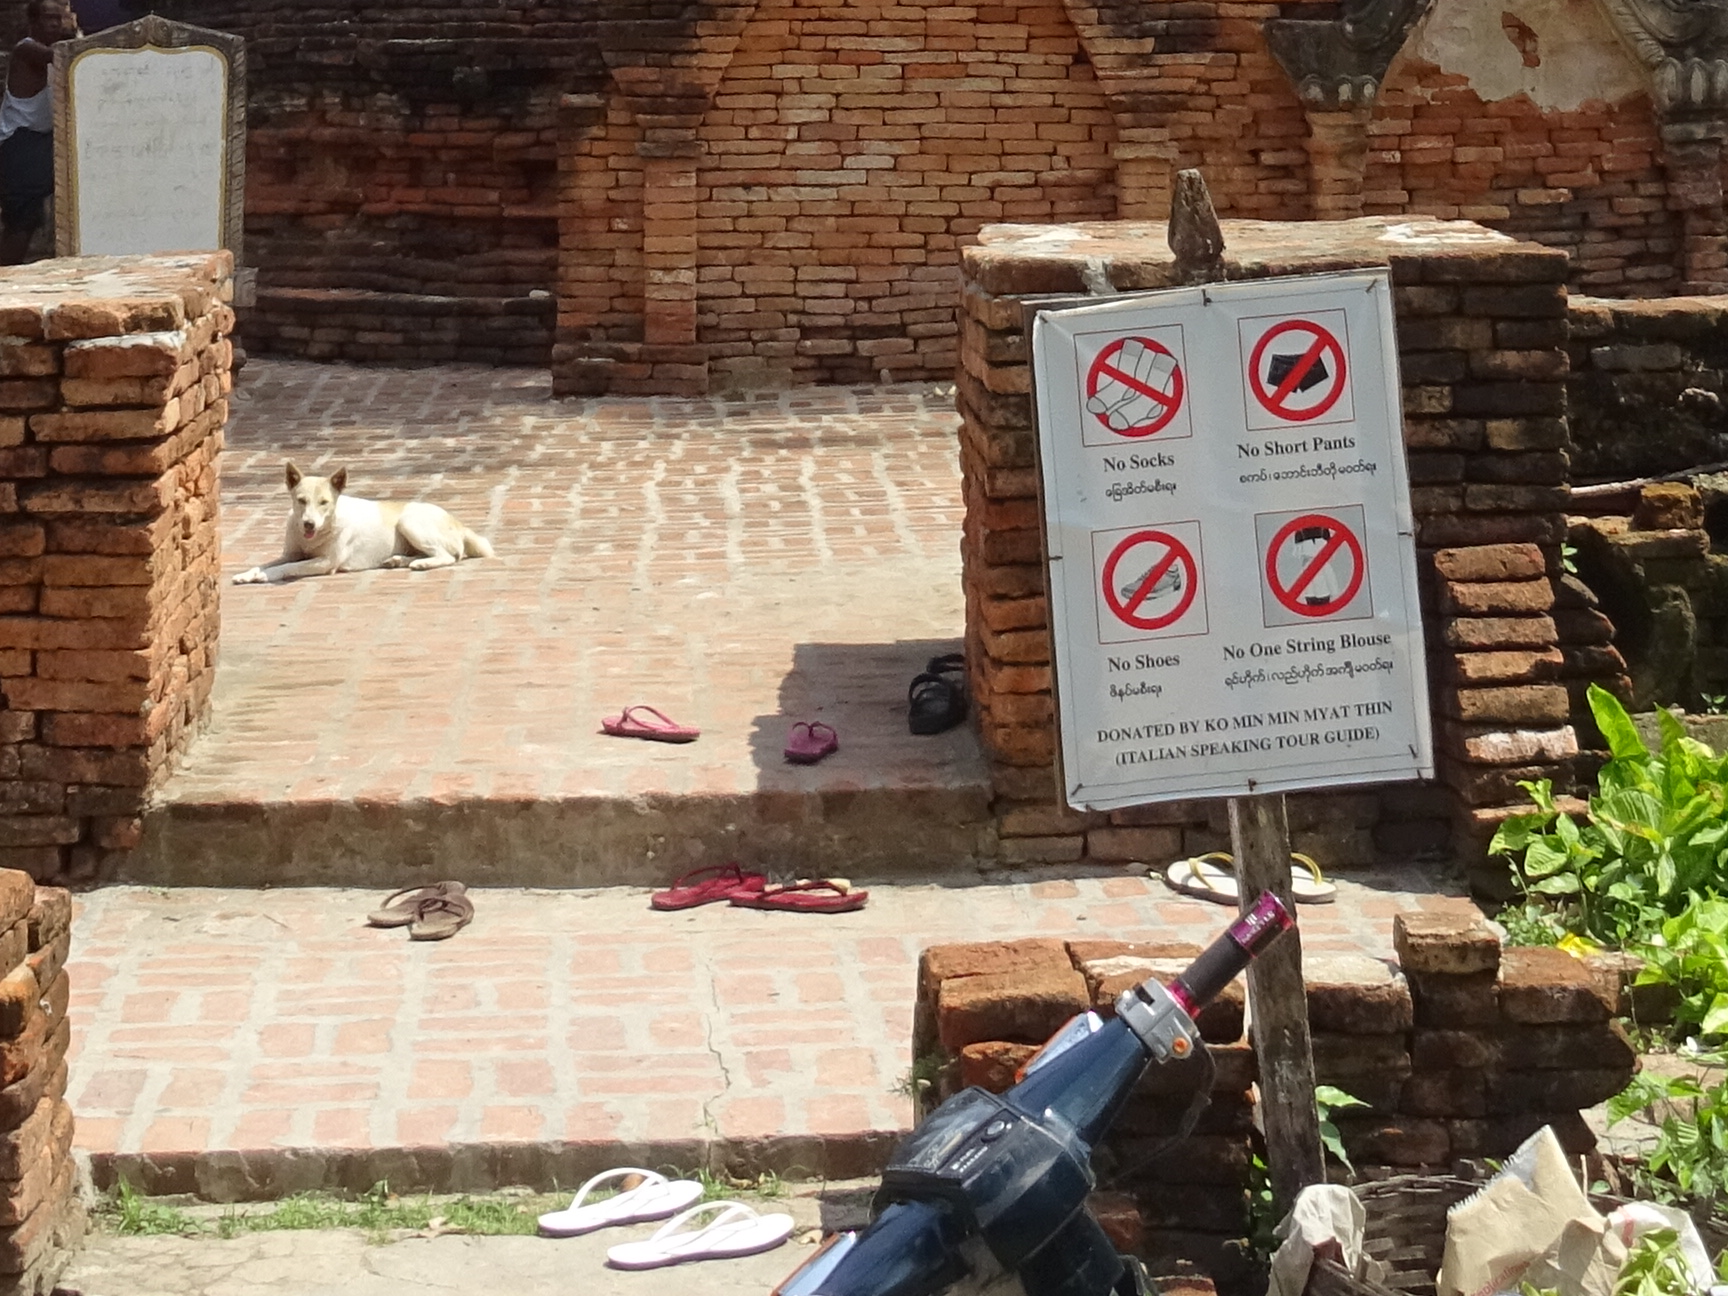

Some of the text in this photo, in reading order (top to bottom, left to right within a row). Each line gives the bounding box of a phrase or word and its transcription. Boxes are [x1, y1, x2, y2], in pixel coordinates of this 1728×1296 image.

[1236, 435, 1356, 458] No Short Pants
[1103, 451, 1175, 473] No Socks
[1222, 632, 1392, 661] No One String Blouse
[1108, 654, 1180, 672] No Shoes
[1097, 700, 1393, 743] DONATED BY KO MIN MIN MYAT THIN
[1115, 725, 1380, 766] (ITALIAN SPEAKING TOUR GUIDE)
